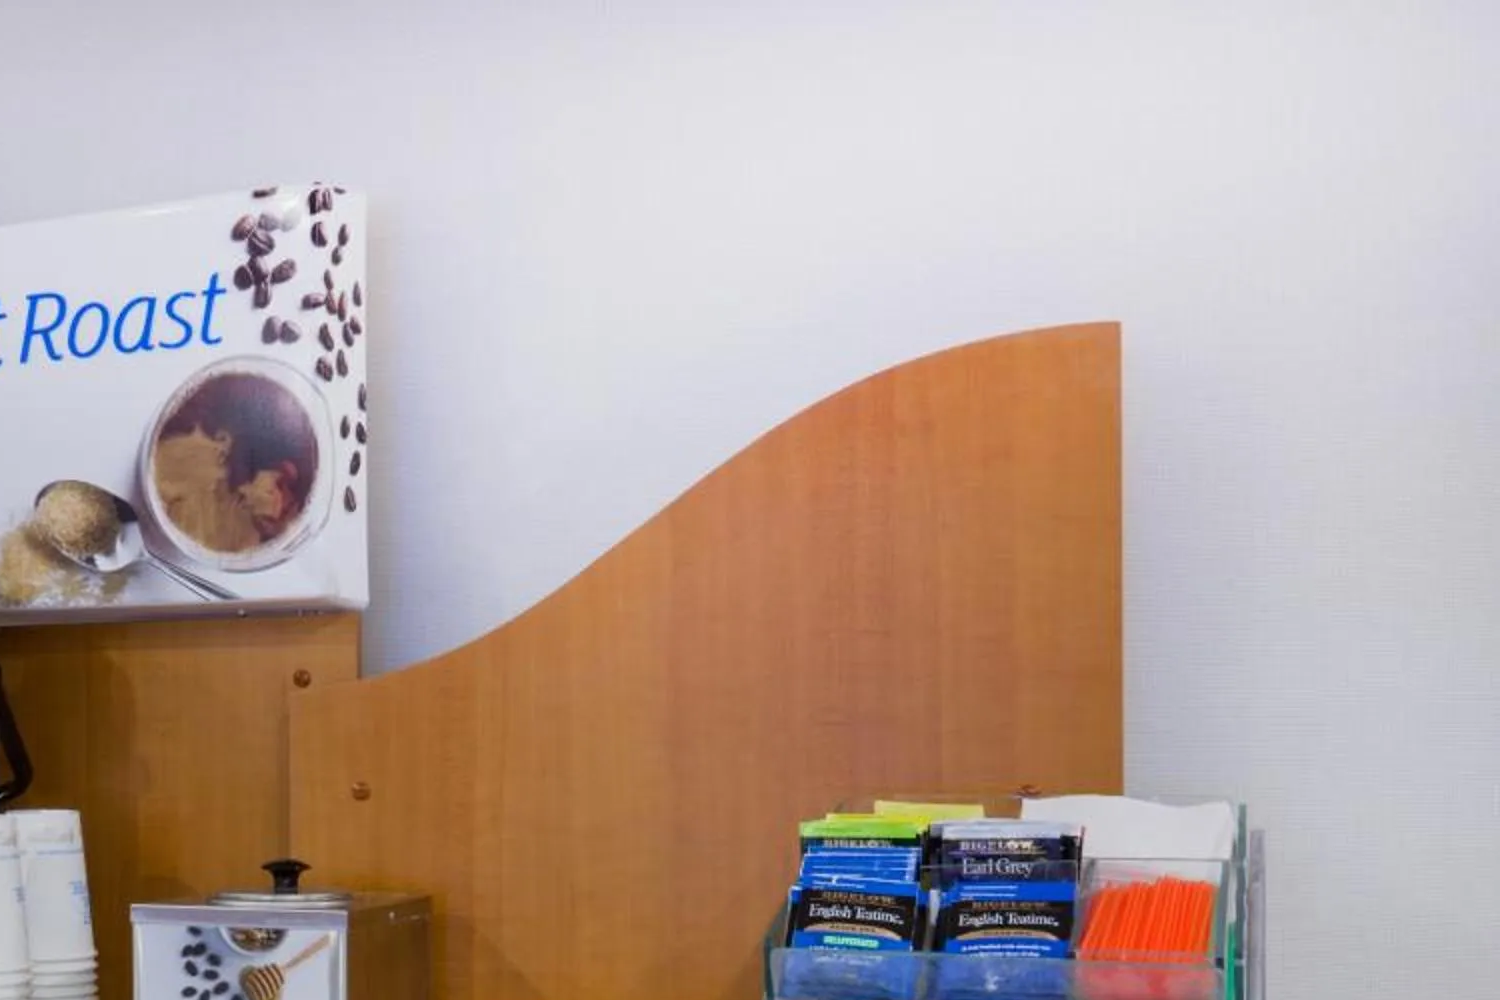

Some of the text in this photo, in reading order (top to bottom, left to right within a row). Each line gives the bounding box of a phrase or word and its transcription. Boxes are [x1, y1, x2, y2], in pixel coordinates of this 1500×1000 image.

[19, 273, 227, 365] Roast
[962, 857, 1033, 879] Earl Grey
[809, 904, 852, 919] English
[959, 912, 1003, 927] English
